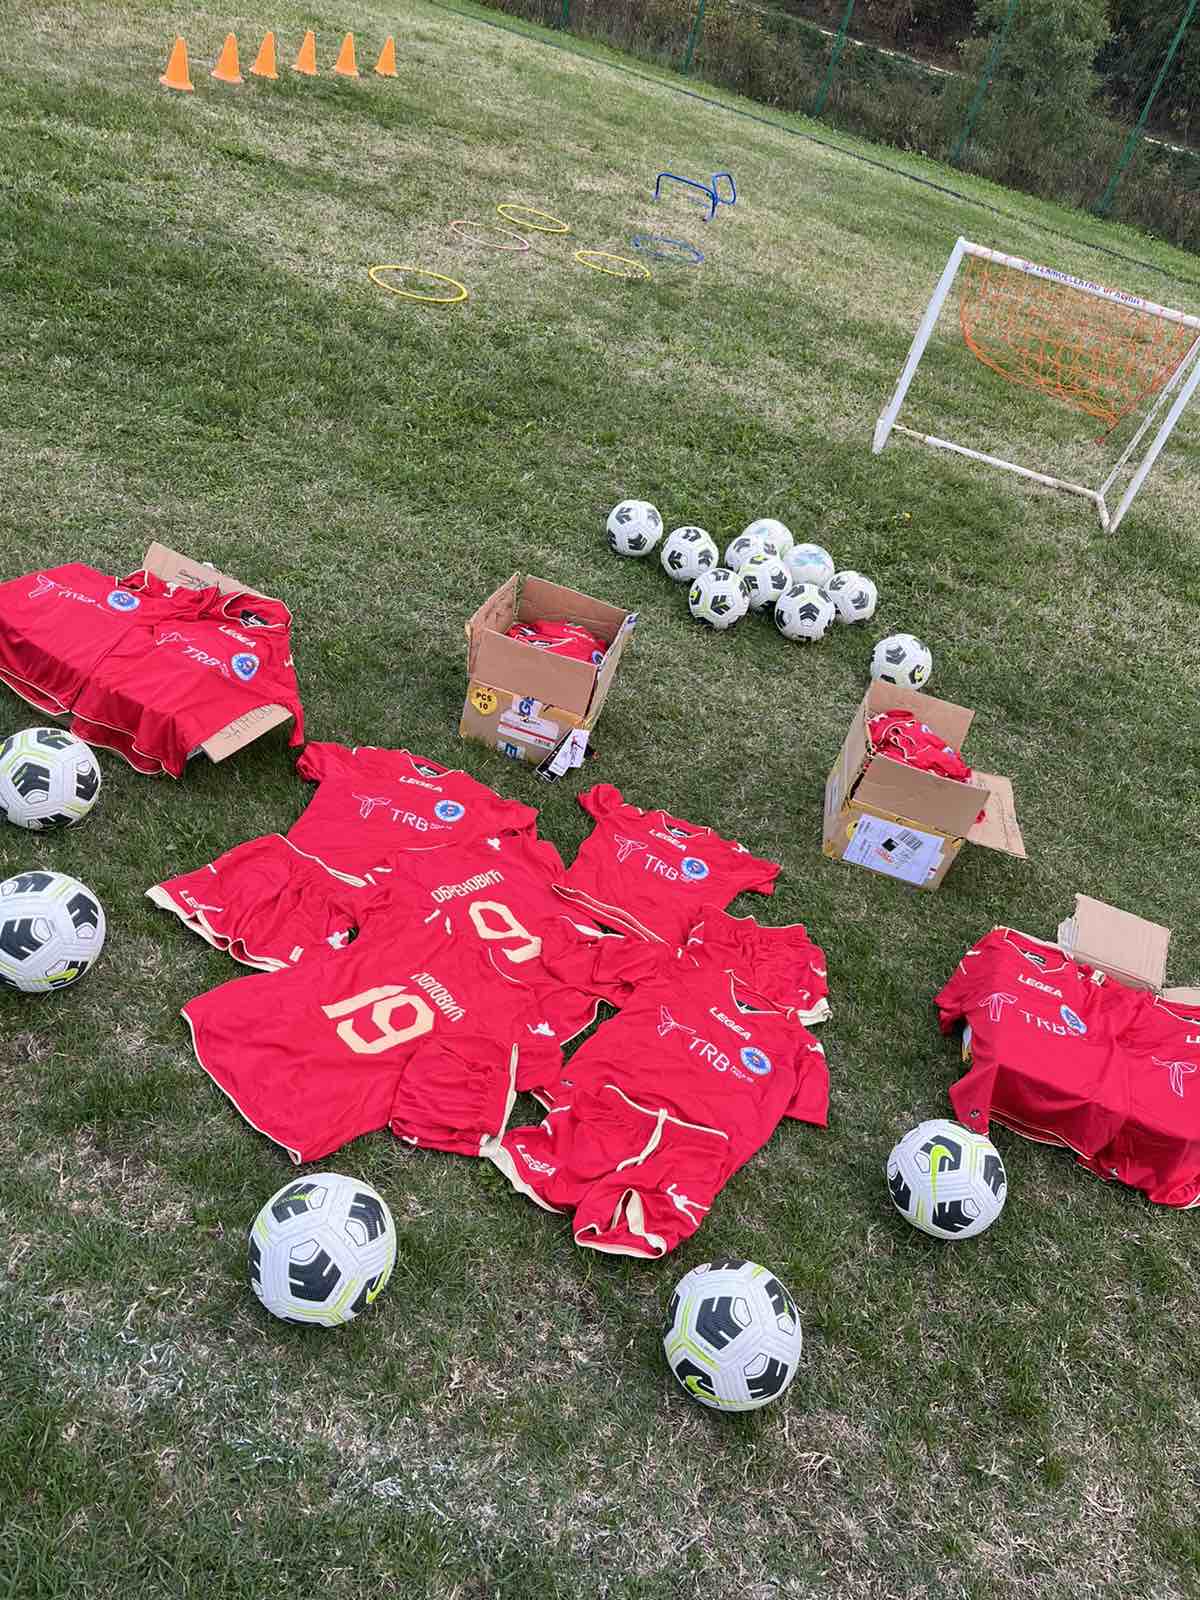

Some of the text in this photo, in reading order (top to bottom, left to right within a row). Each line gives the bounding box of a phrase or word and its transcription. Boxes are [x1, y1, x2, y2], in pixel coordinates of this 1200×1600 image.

[182, 645, 220, 667] TRB
[476, 691, 493, 702] PCS
[479, 701, 489, 711] 10
[399, 775, 444, 793] LEGEA
[390, 807, 428, 832] TRB
[645, 853, 678, 881] TRB
[468, 900, 542, 964] 9
[1017, 973, 1064, 999] LEGEA
[320, 984, 435, 1054] 19
[709, 1005, 753, 1041] LEGEA
[688, 1035, 731, 1072] TRB
[515, 1143, 557, 1177] LEGEA
